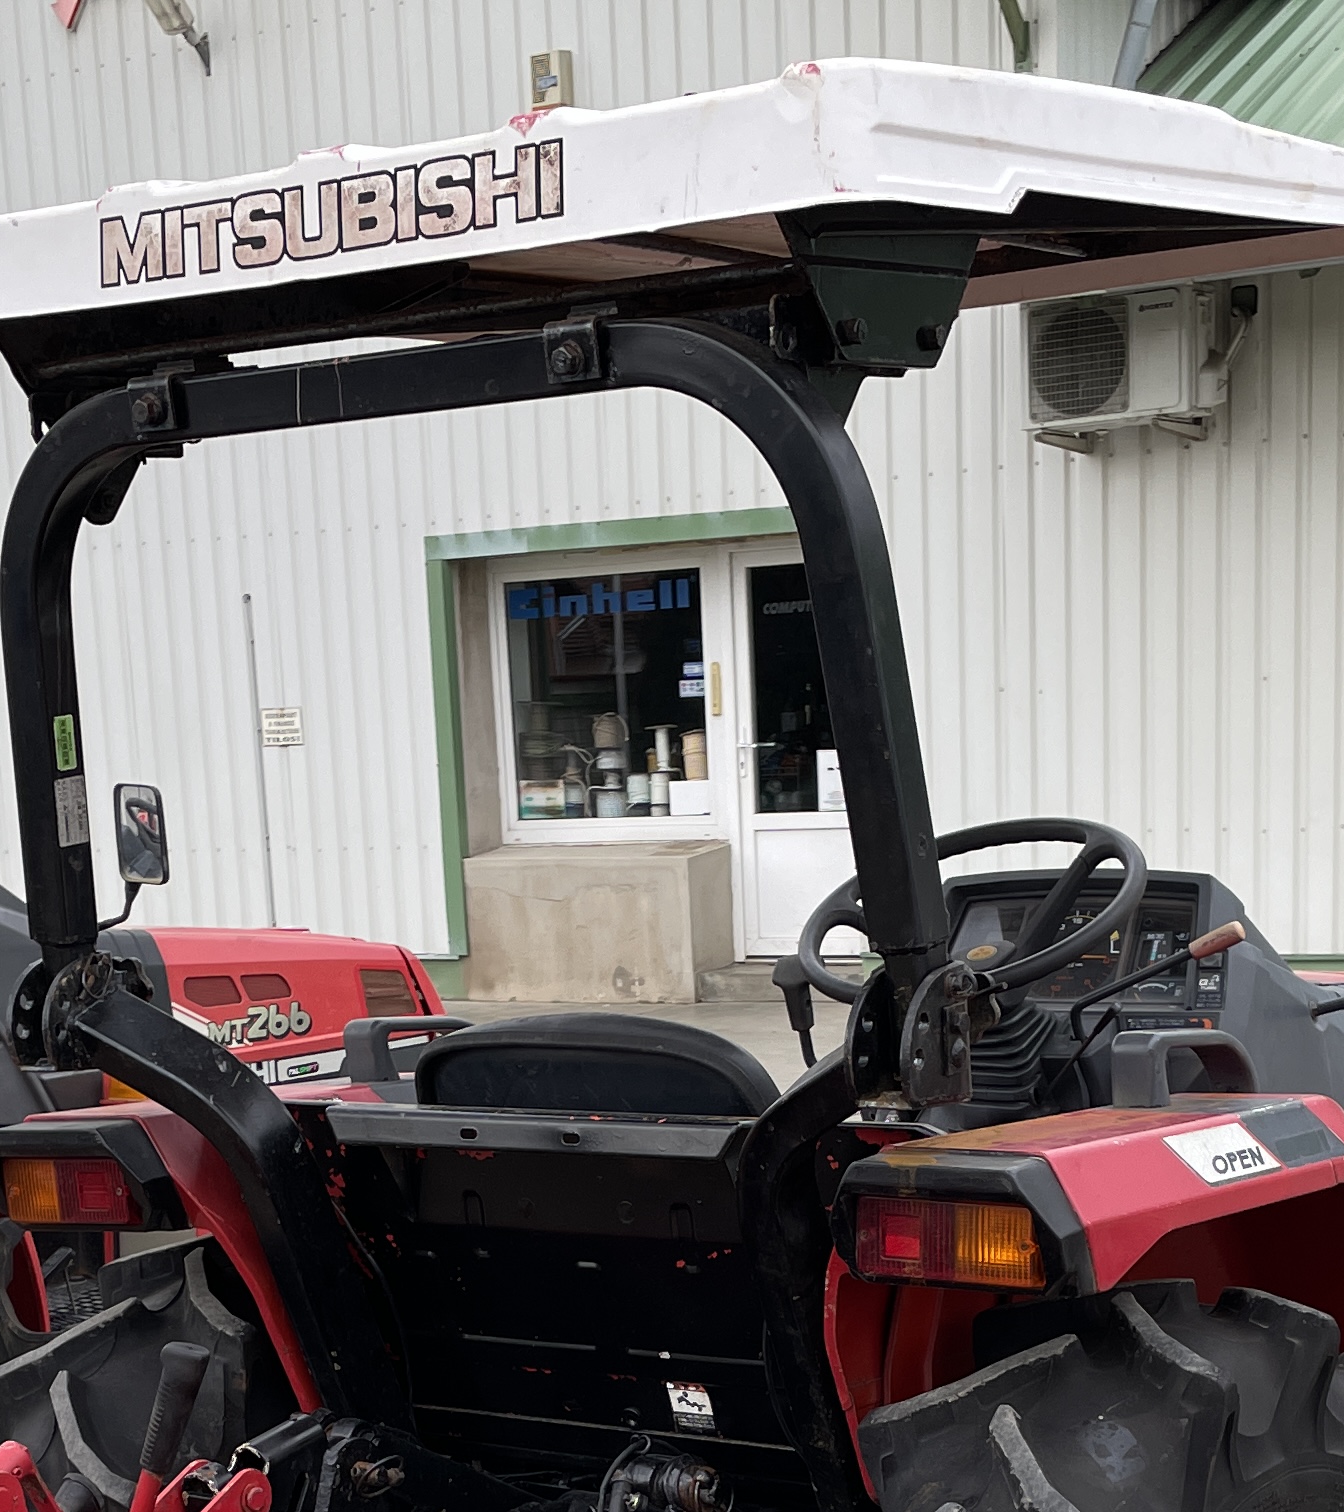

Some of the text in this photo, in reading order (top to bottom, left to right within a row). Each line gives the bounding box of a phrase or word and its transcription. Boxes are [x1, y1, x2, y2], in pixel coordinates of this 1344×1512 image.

[99, 137, 565, 290] MITSUBISHI
[508, 577, 691, 620] Einhell
[207, 1001, 312, 1046] MT266
[1212, 1146, 1265, 1174] OPEN
